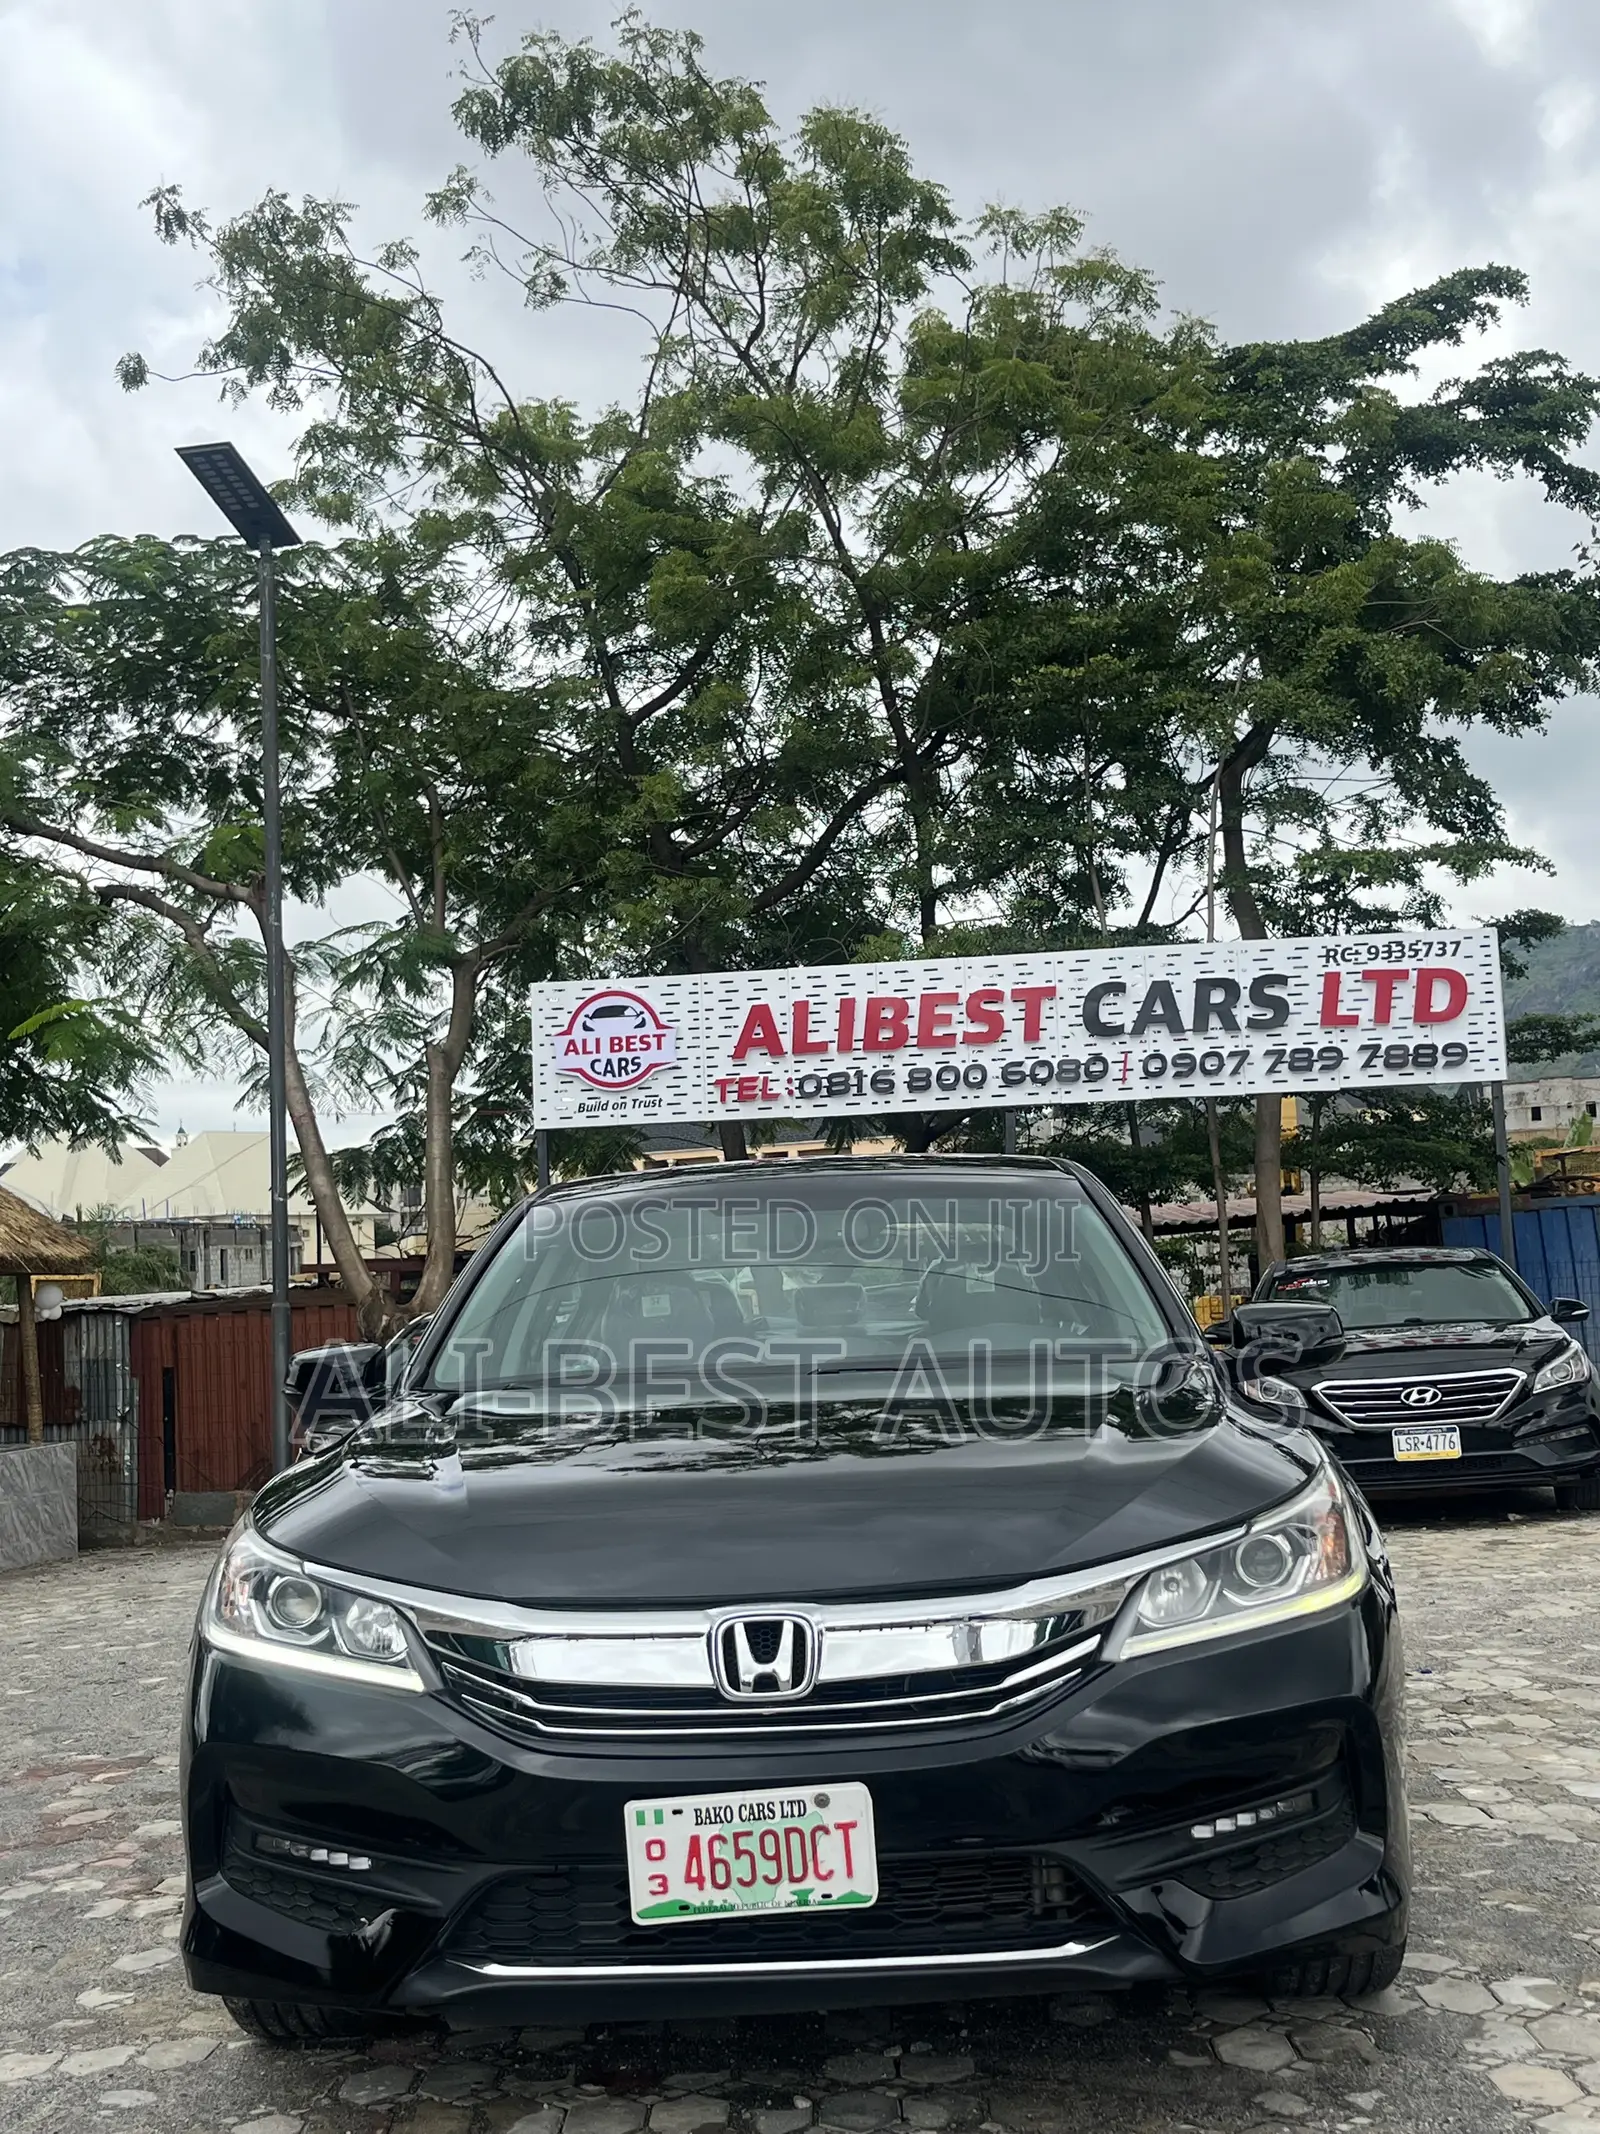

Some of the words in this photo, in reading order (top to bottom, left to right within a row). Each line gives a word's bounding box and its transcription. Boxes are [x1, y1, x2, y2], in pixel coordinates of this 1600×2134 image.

[1366, 940, 1462, 962] 9335737
[731, 985, 1057, 1060] ALIBEST
[1082, 973, 1291, 1037] CARS
[1319, 967, 1470, 1029] LTD
[563, 1037, 601, 1056] ALI
[609, 1033, 666, 1054] BEST
[589, 1056, 642, 1078] CARS
[798, 1068, 896, 1099] 0816
[906, 1062, 988, 1094] 800
[1000, 1054, 1110, 1086] 6080
[1141, 1049, 1251, 1079] 0907
[1263, 1044, 1344, 1075] 789
[1356, 1041, 1470, 1070] 7889
[577, 1100, 609, 1114] Build
[612, 1101, 627, 1111] on
[631, 1097, 663, 1110] Trust
[693, 1805, 734, 1826] BAKO
[738, 1802, 776, 1821] CARS
[779, 1799, 807, 1818] LTD
[684, 1820, 858, 1891] 4659DCT
